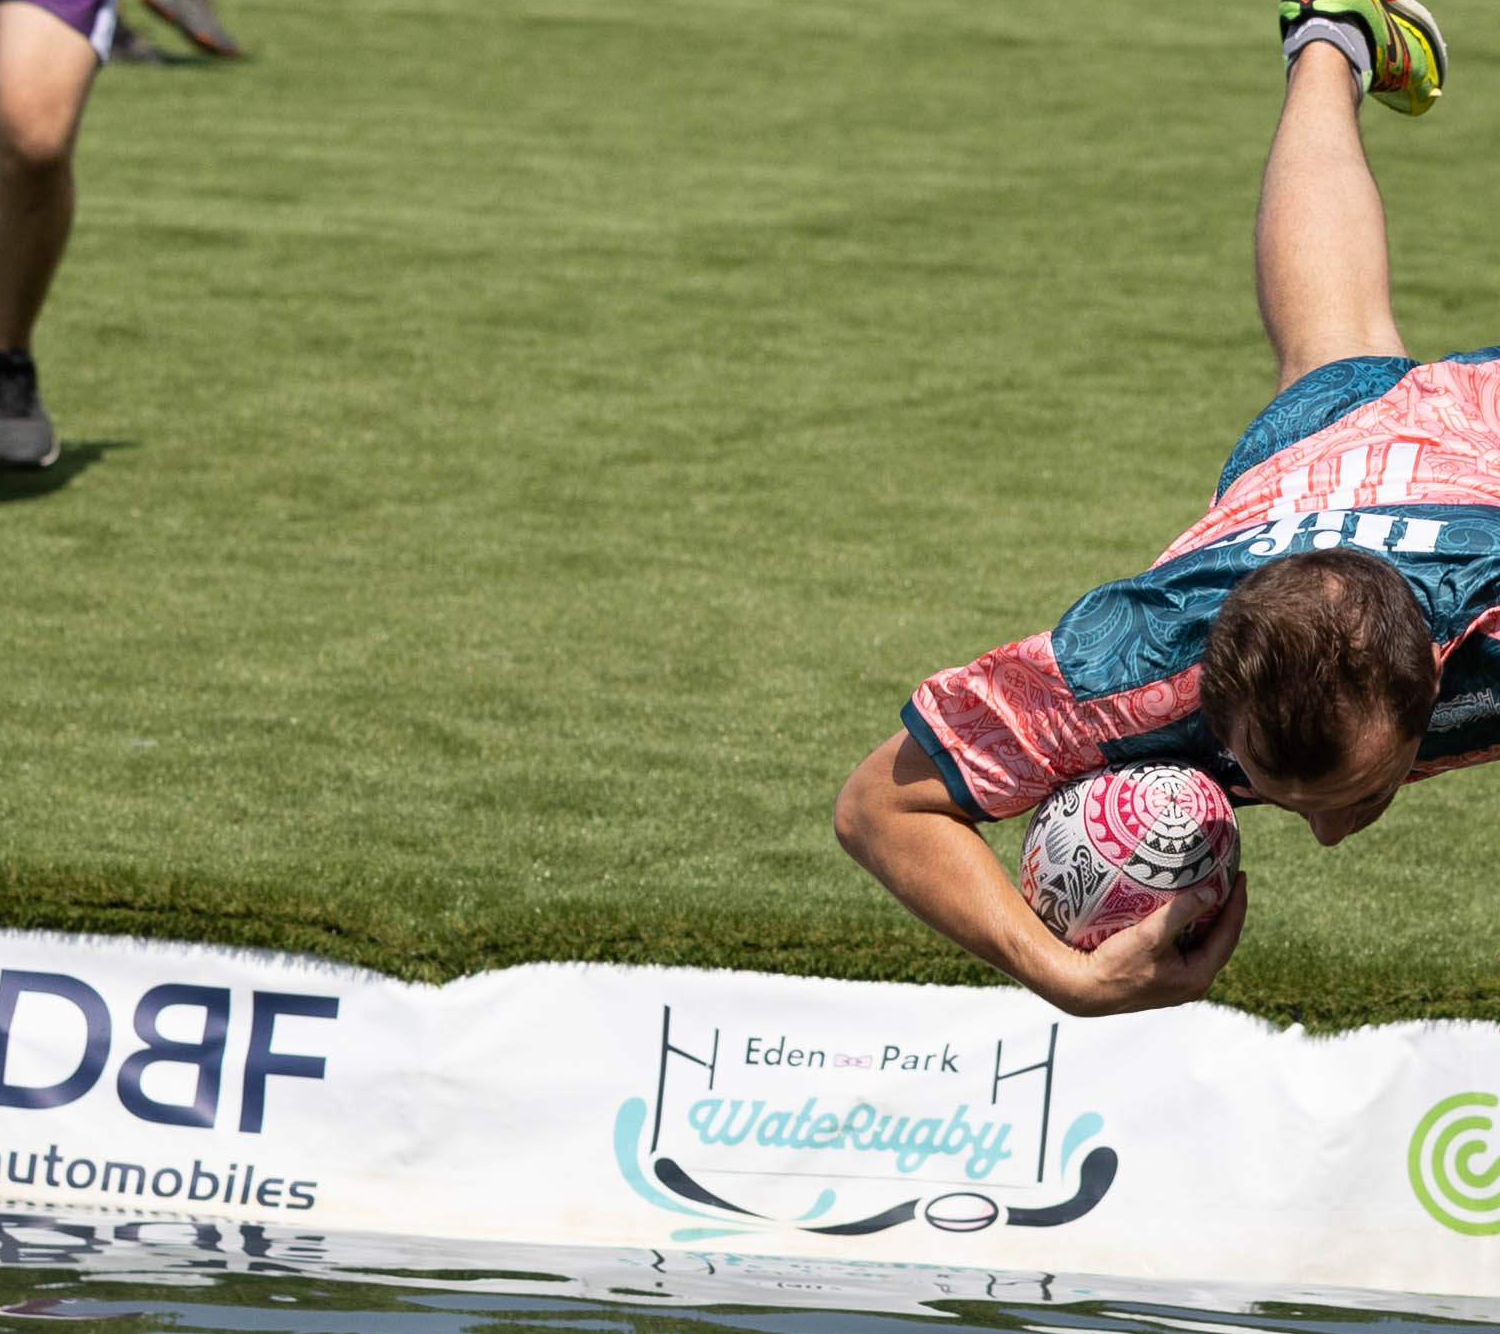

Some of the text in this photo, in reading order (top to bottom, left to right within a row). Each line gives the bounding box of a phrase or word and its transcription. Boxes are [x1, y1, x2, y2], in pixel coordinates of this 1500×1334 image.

[744, 1036, 960, 1074] Eden Park
[686, 1097, 1013, 1179] WateRugby
